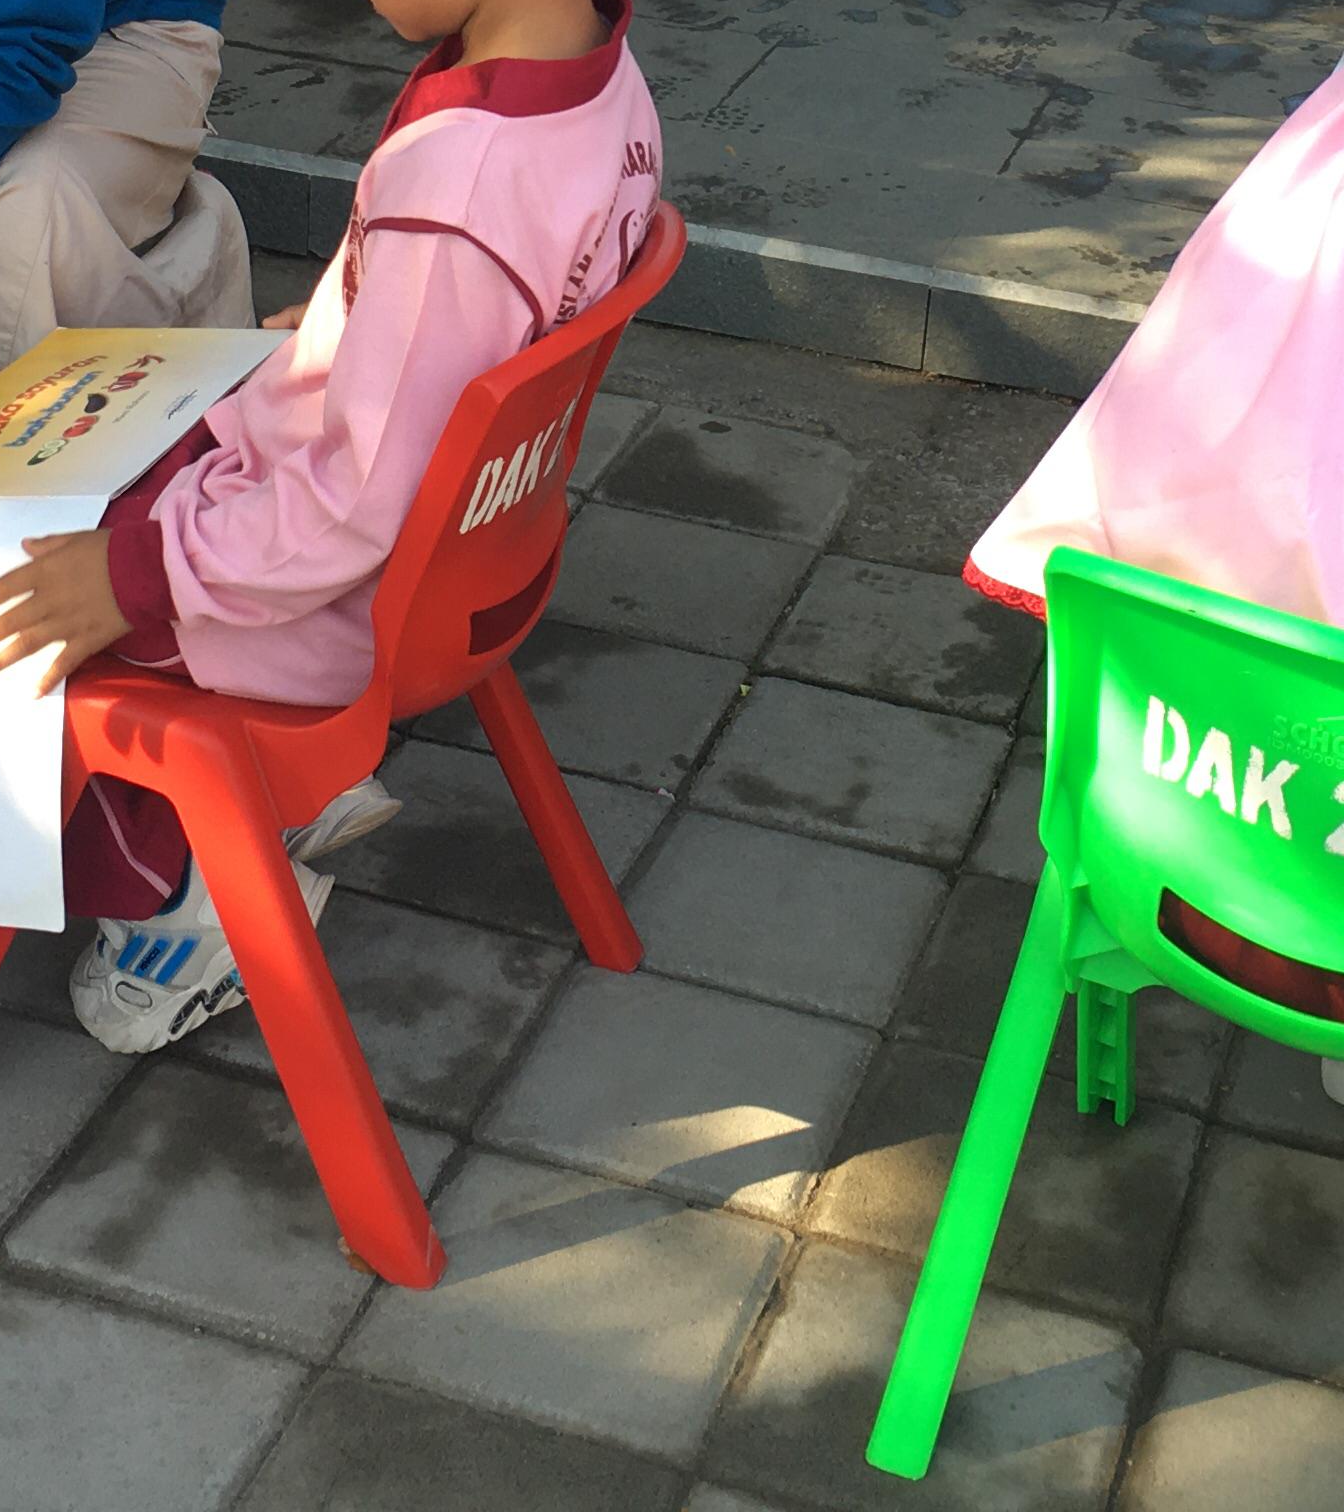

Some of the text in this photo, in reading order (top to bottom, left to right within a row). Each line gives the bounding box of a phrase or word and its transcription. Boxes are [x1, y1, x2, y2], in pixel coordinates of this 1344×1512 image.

[15, 355, 109, 401] sayuran
[459, 419, 558, 535] DAK
[1141, 694, 1301, 840] DAK
